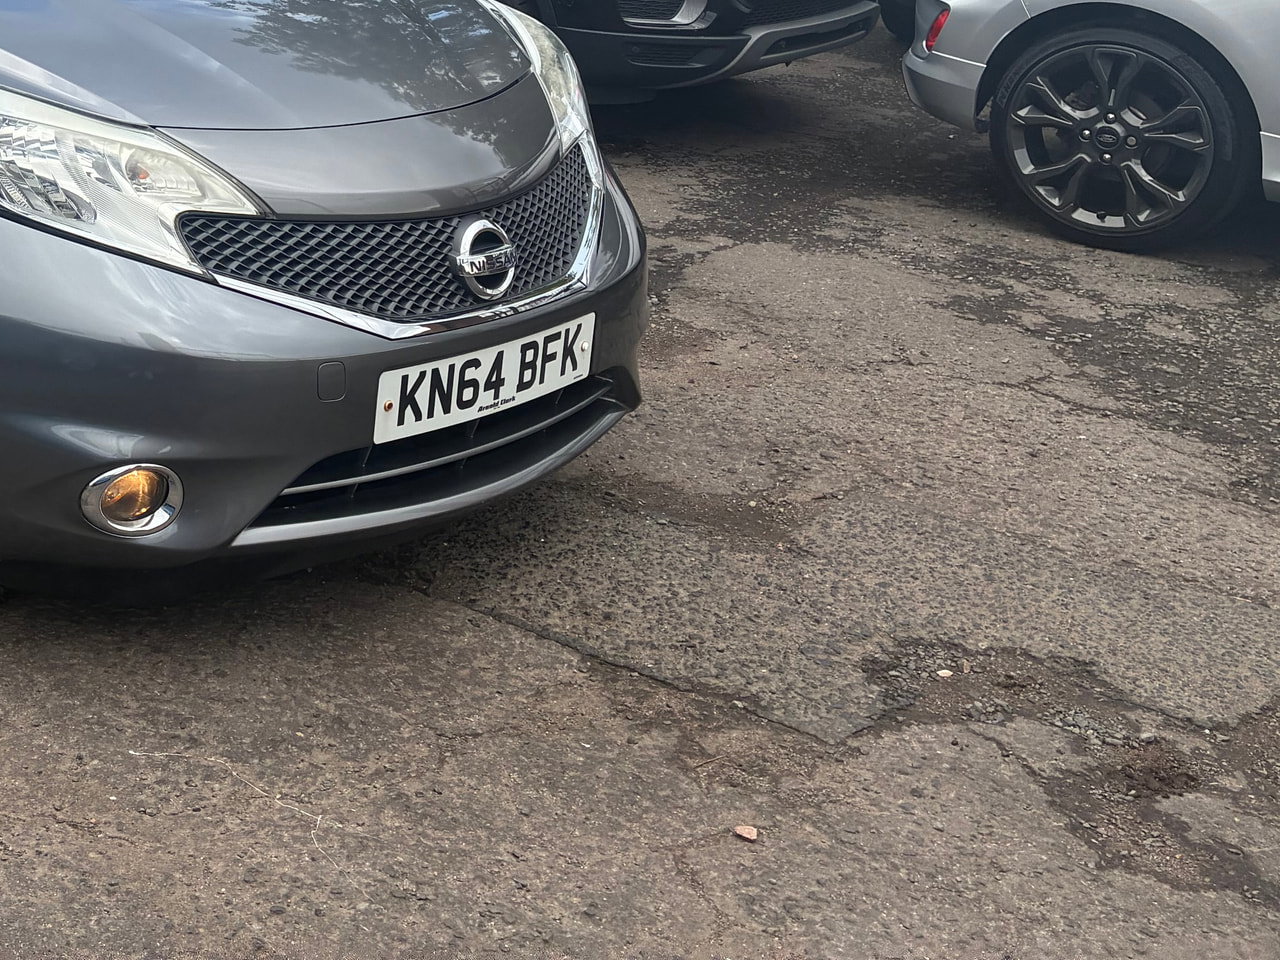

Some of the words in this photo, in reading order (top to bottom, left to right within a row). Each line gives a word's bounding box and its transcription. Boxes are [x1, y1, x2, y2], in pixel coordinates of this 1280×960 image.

[470, 250, 517, 274] NISSAN
[397, 350, 506, 427] KN64
[516, 323, 583, 393] BFK
